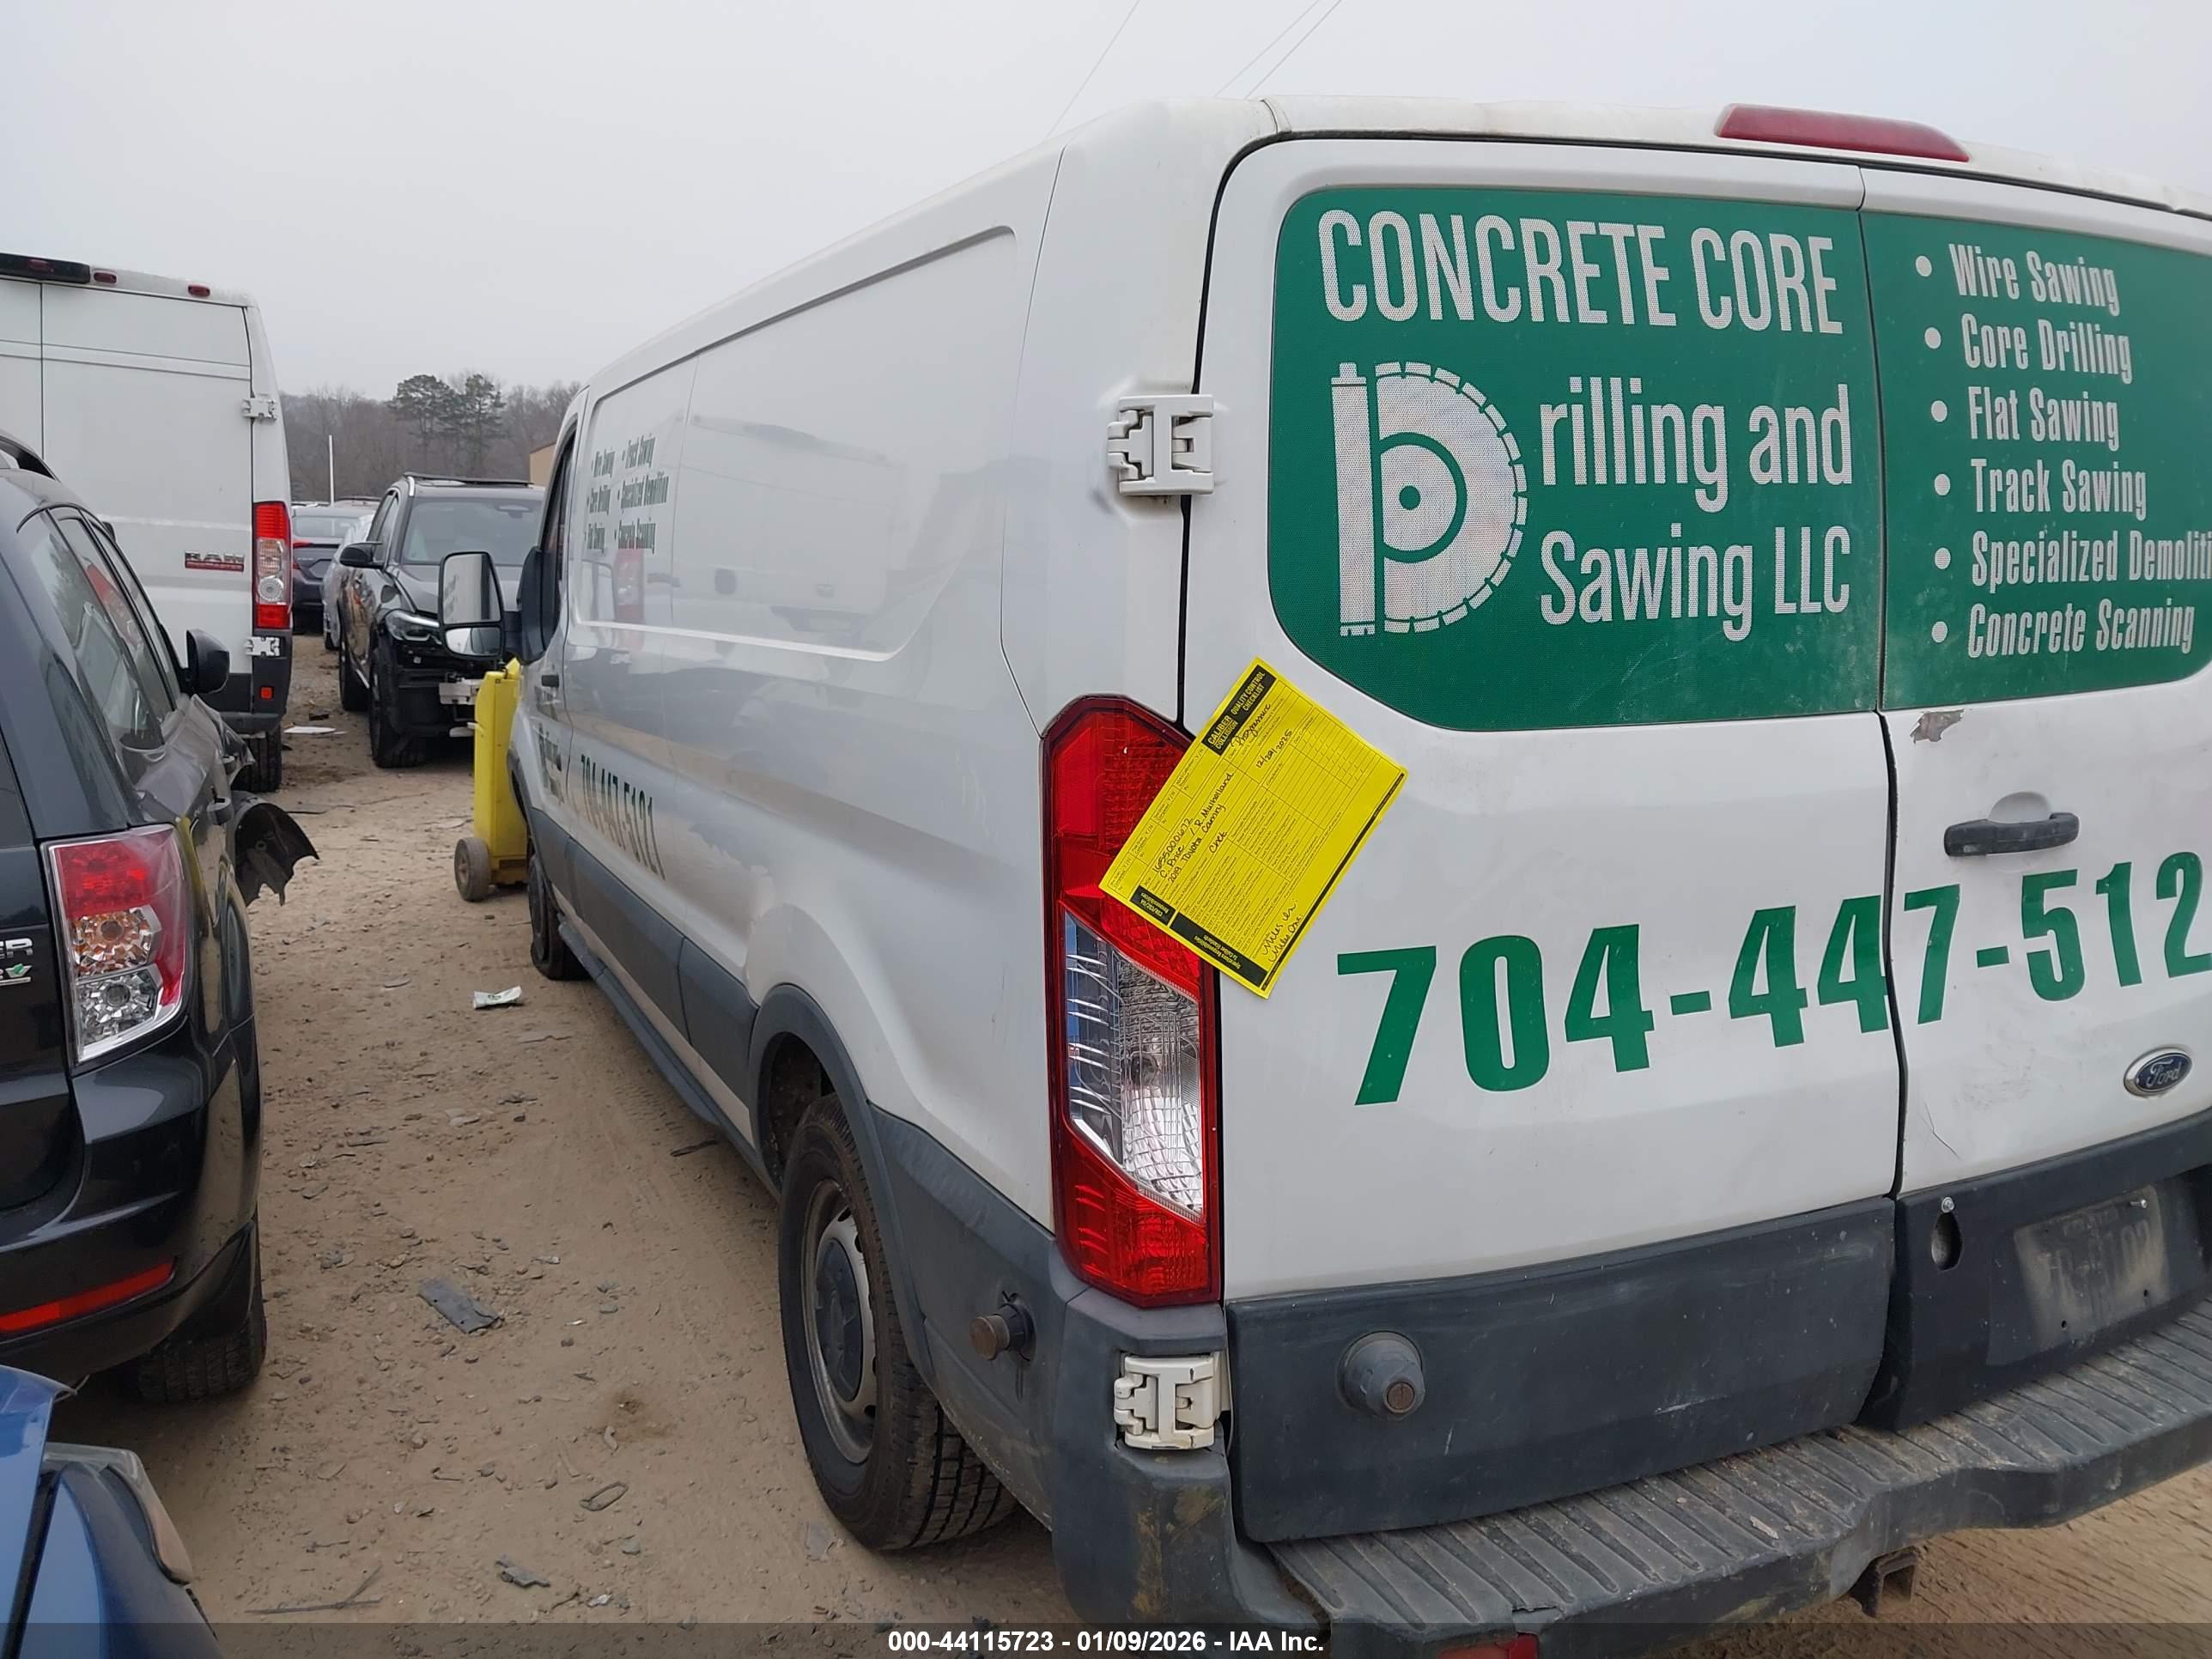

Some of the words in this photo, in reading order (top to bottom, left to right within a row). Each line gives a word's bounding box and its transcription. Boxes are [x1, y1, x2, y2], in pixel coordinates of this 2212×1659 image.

[1318, 209, 1677, 326] CONCRETE
[1690, 227, 1843, 334] CORE
[1948, 243, 2020, 300] Wire
[2027, 251, 2119, 316] Sawing
[1961, 313, 2028, 369] Core
[2038, 319, 2132, 384] Drilling
[1748, 384, 1853, 485] and
[1968, 386, 2020, 440] Flat
[2029, 388, 2119, 451] Sawing
[1971, 459, 2051, 513] Track
[2062, 459, 2146, 520] Sawing
[185, 550, 245, 564] RAM
[1540, 523, 1753, 641] Sawing
[1775, 526, 1850, 614] LLC
[1972, 530, 2118, 593] Specialized
[1968, 603, 2087, 658] Concrete
[2096, 599, 2194, 654] Scanning
[1230, 691, 1249, 715] QUALITY
[1244, 669, 1265, 696] CONTROL
[1242, 682, 1265, 712] CHECKLIST
[1206, 714, 1232, 745] CALIBER
[1214, 719, 1238, 750] COLLISION
[1166, 842, 1186, 866] Price
[1199, 769, 1235, 817] Mulholland
[1166, 865, 1182, 884] 2019
[1200, 802, 1228, 836] Camry
